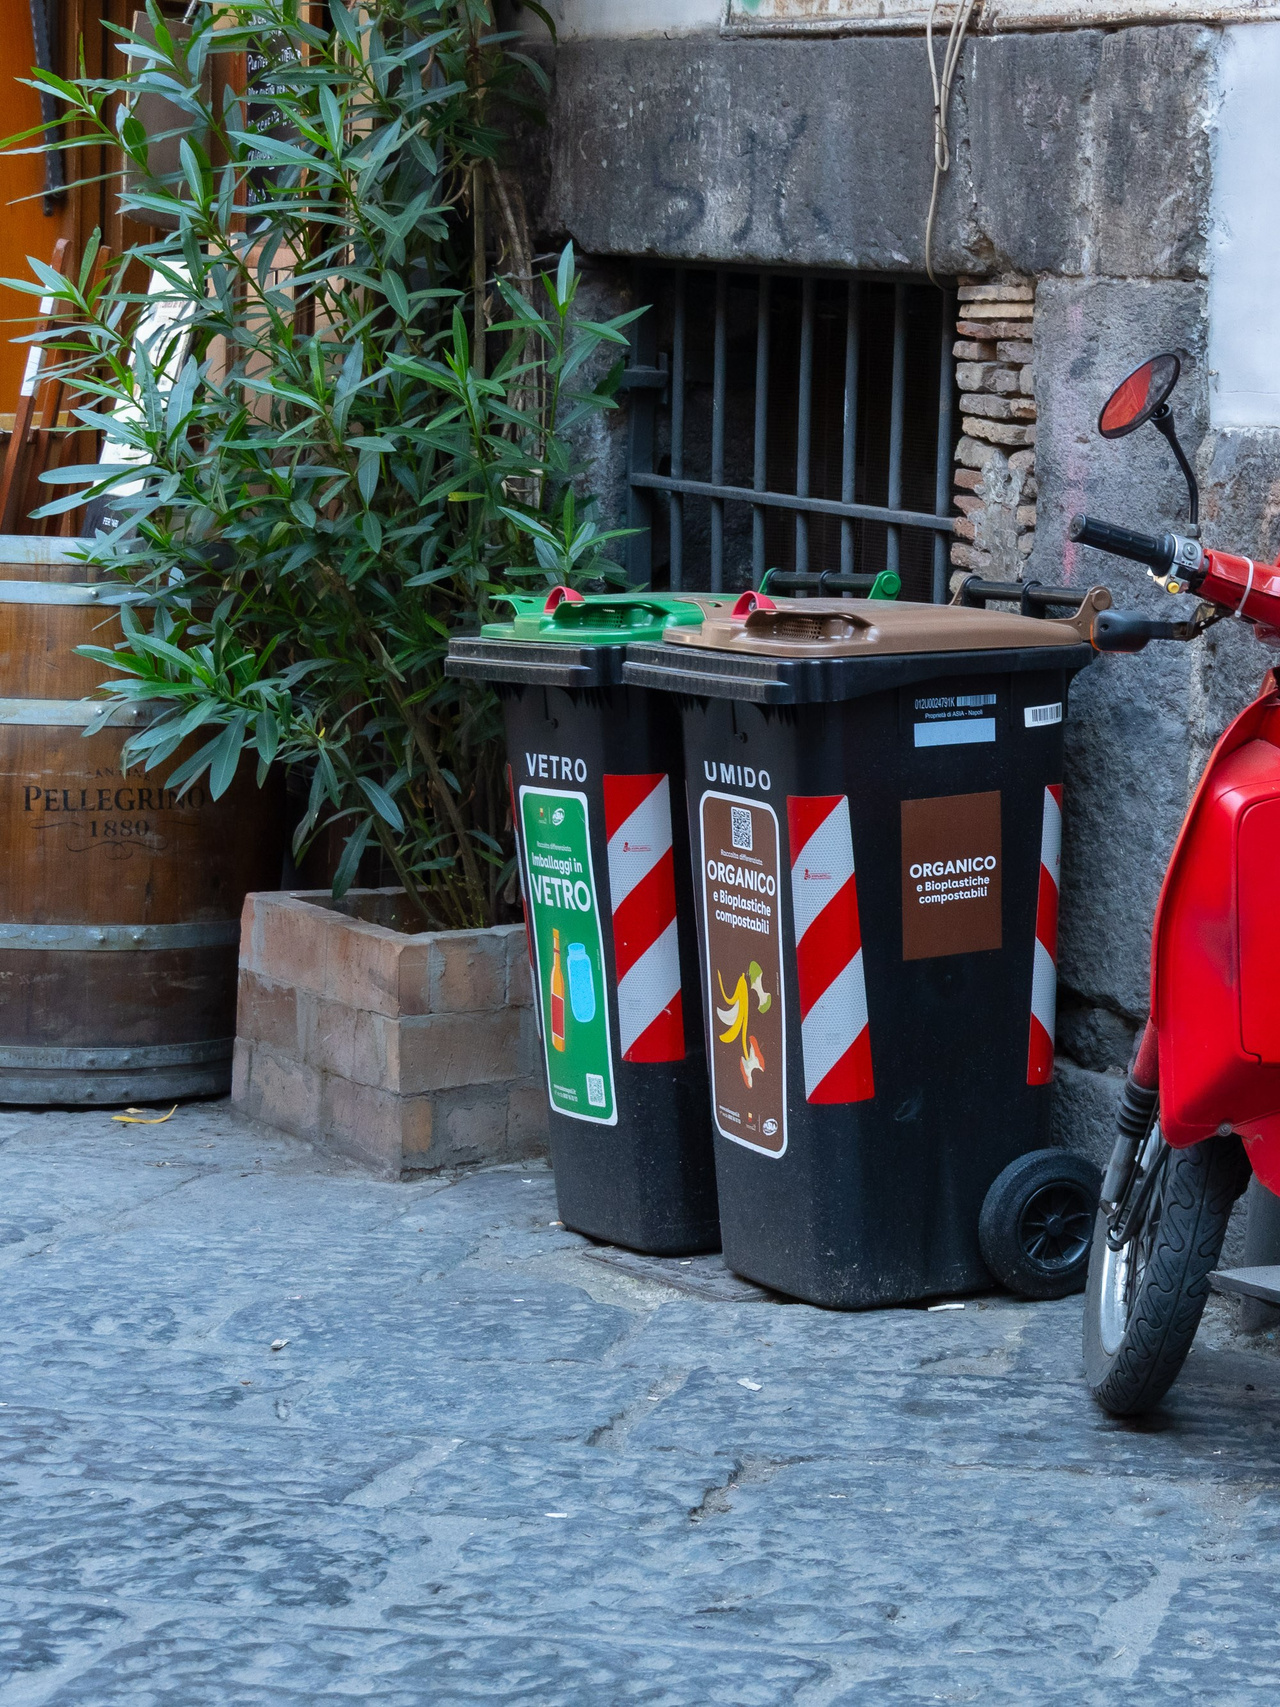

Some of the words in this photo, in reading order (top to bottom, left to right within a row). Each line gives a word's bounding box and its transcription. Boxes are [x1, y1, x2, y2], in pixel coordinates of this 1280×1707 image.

[967, 709, 983, 718] Napoli
[525, 752, 588, 783] VETRO
[703, 760, 772, 791] UMIDO
[22, 784, 206, 812] PELLEGRINO
[88, 819, 151, 838] 1880
[531, 852, 573, 876] Imballaggi
[573, 858, 583, 874] in
[720, 848, 740, 861] Raccolta
[739, 852, 764, 866] differenziata
[909, 855, 997, 879] ORGANICO
[707, 859, 776, 897] ORGANICO
[916, 884, 923, 893] e
[924, 875, 990, 893] Bioplastiche
[531, 872, 592, 913] VETRO
[712, 890, 719, 902] e
[719, 889, 772, 917] Bioplastiche
[918, 886, 988, 905] compostabili
[715, 908, 770, 936] compostabili
